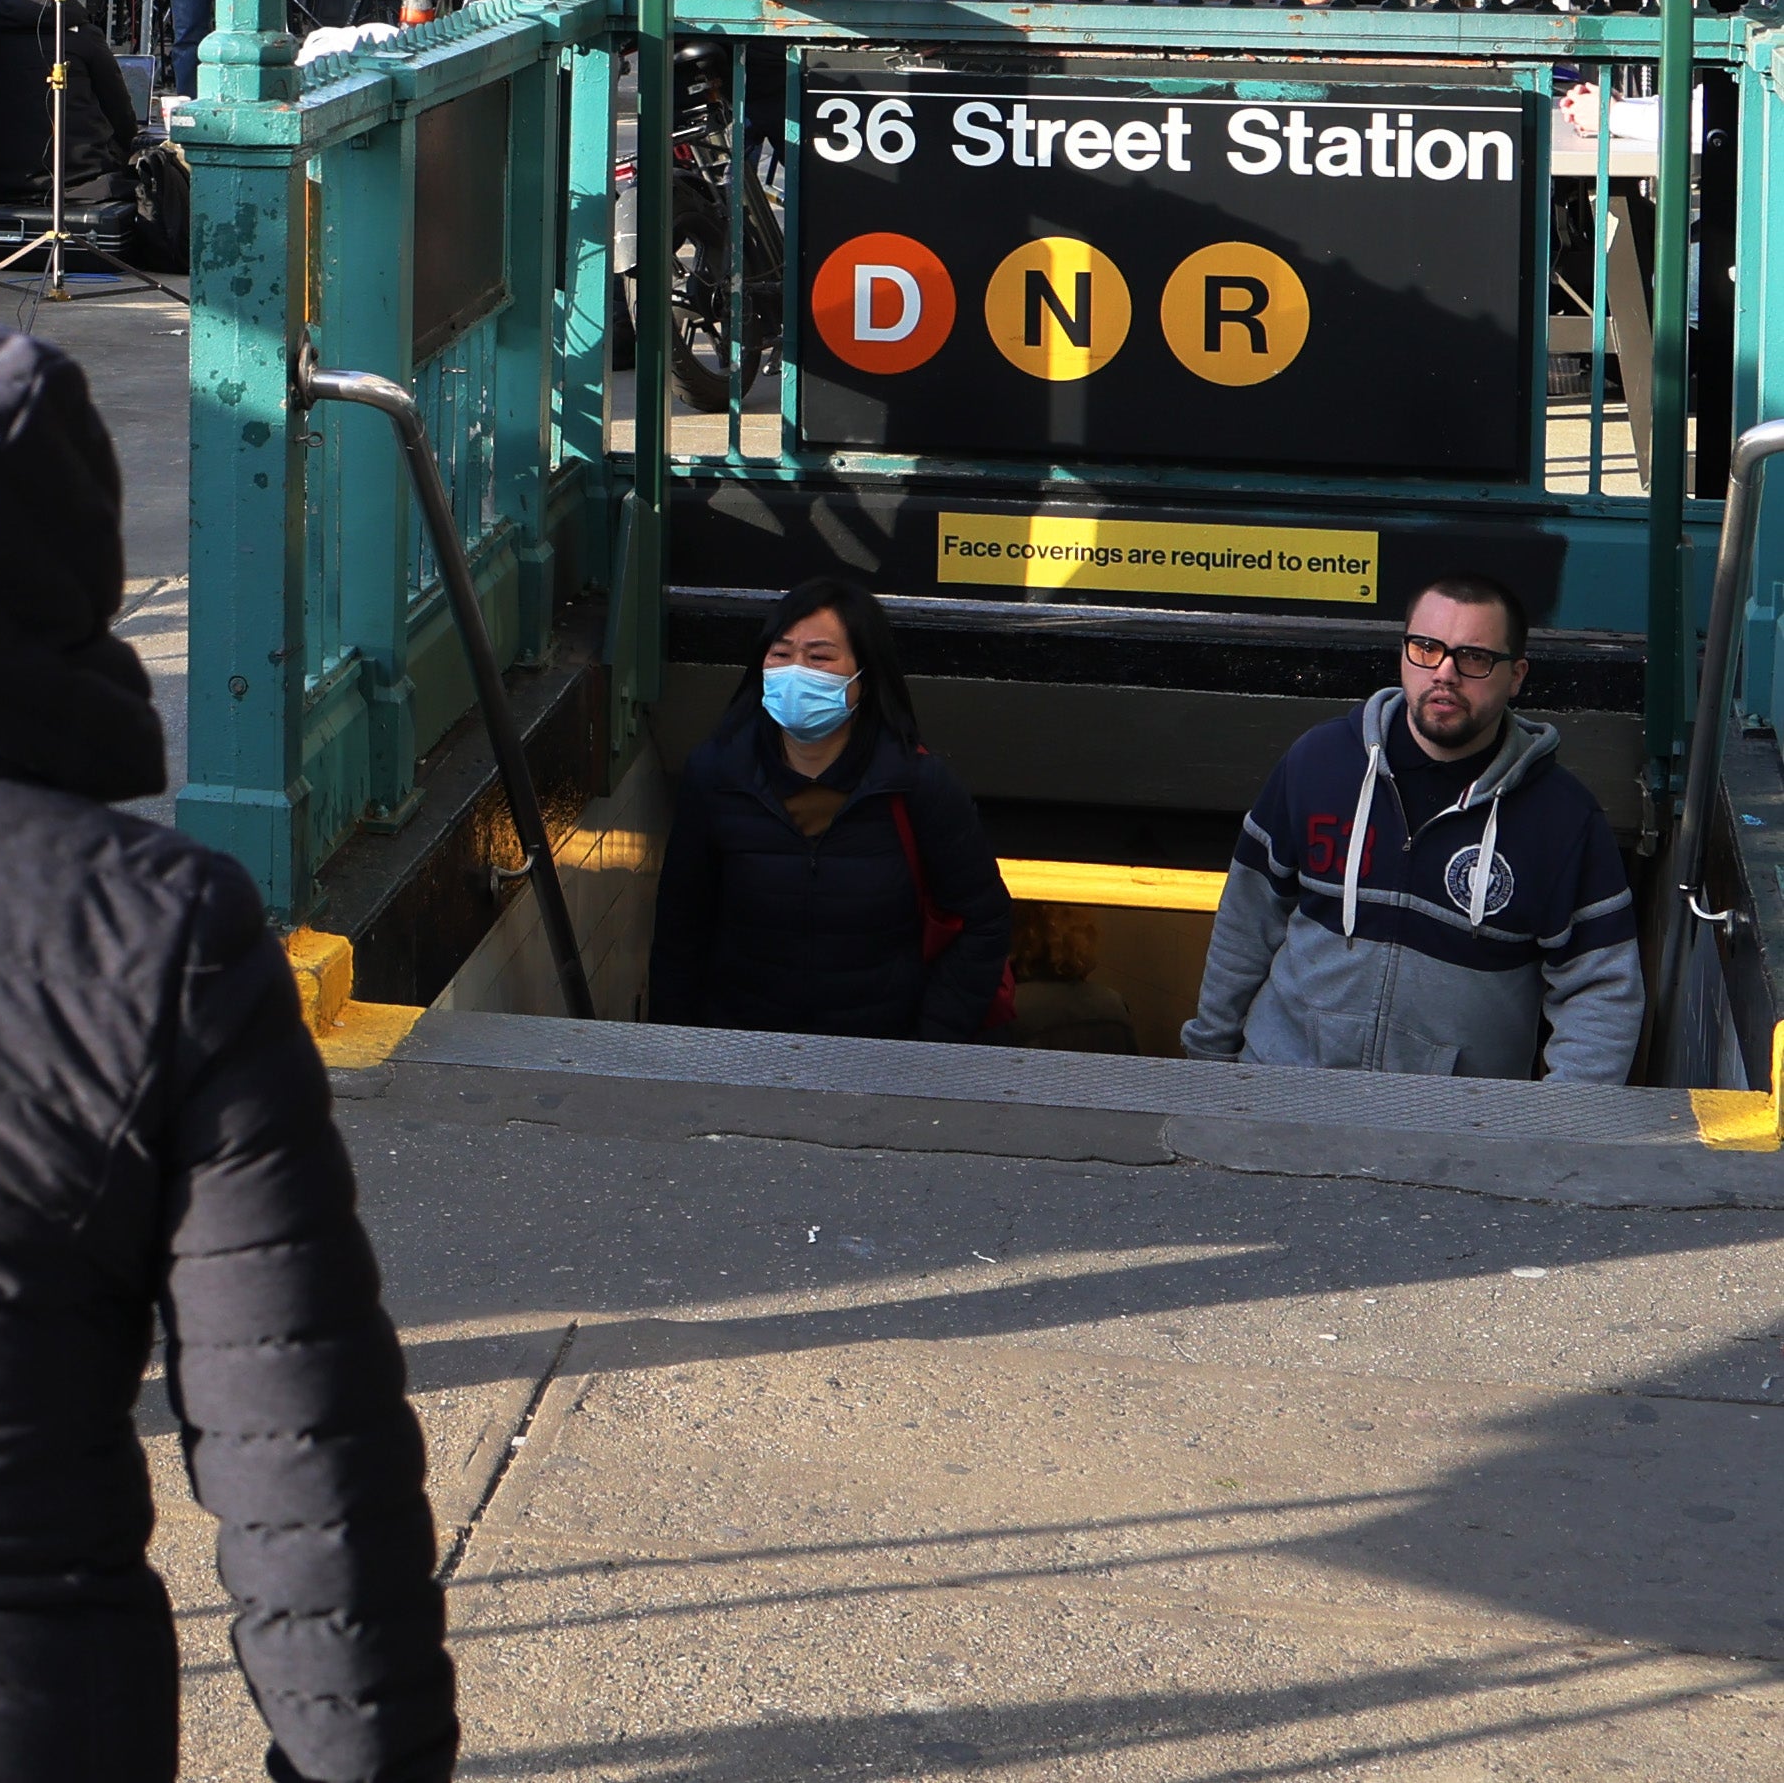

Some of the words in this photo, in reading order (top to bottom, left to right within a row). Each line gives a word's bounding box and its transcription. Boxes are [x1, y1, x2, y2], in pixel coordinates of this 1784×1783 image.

[813, 97, 915, 166] 36
[952, 101, 1190, 173] Street
[1227, 108, 1514, 182] Station
[853, 264, 922, 343] D
[1023, 270, 1092, 348] N
[1203, 276, 1271, 355] R
[944, 534, 1002, 562] Face
[1006, 539, 1123, 573] coverings
[1127, 549, 1166, 569] are
[1169, 545, 1271, 579] required
[1277, 552, 1302, 574] to
[1307, 554, 1371, 578] enter
